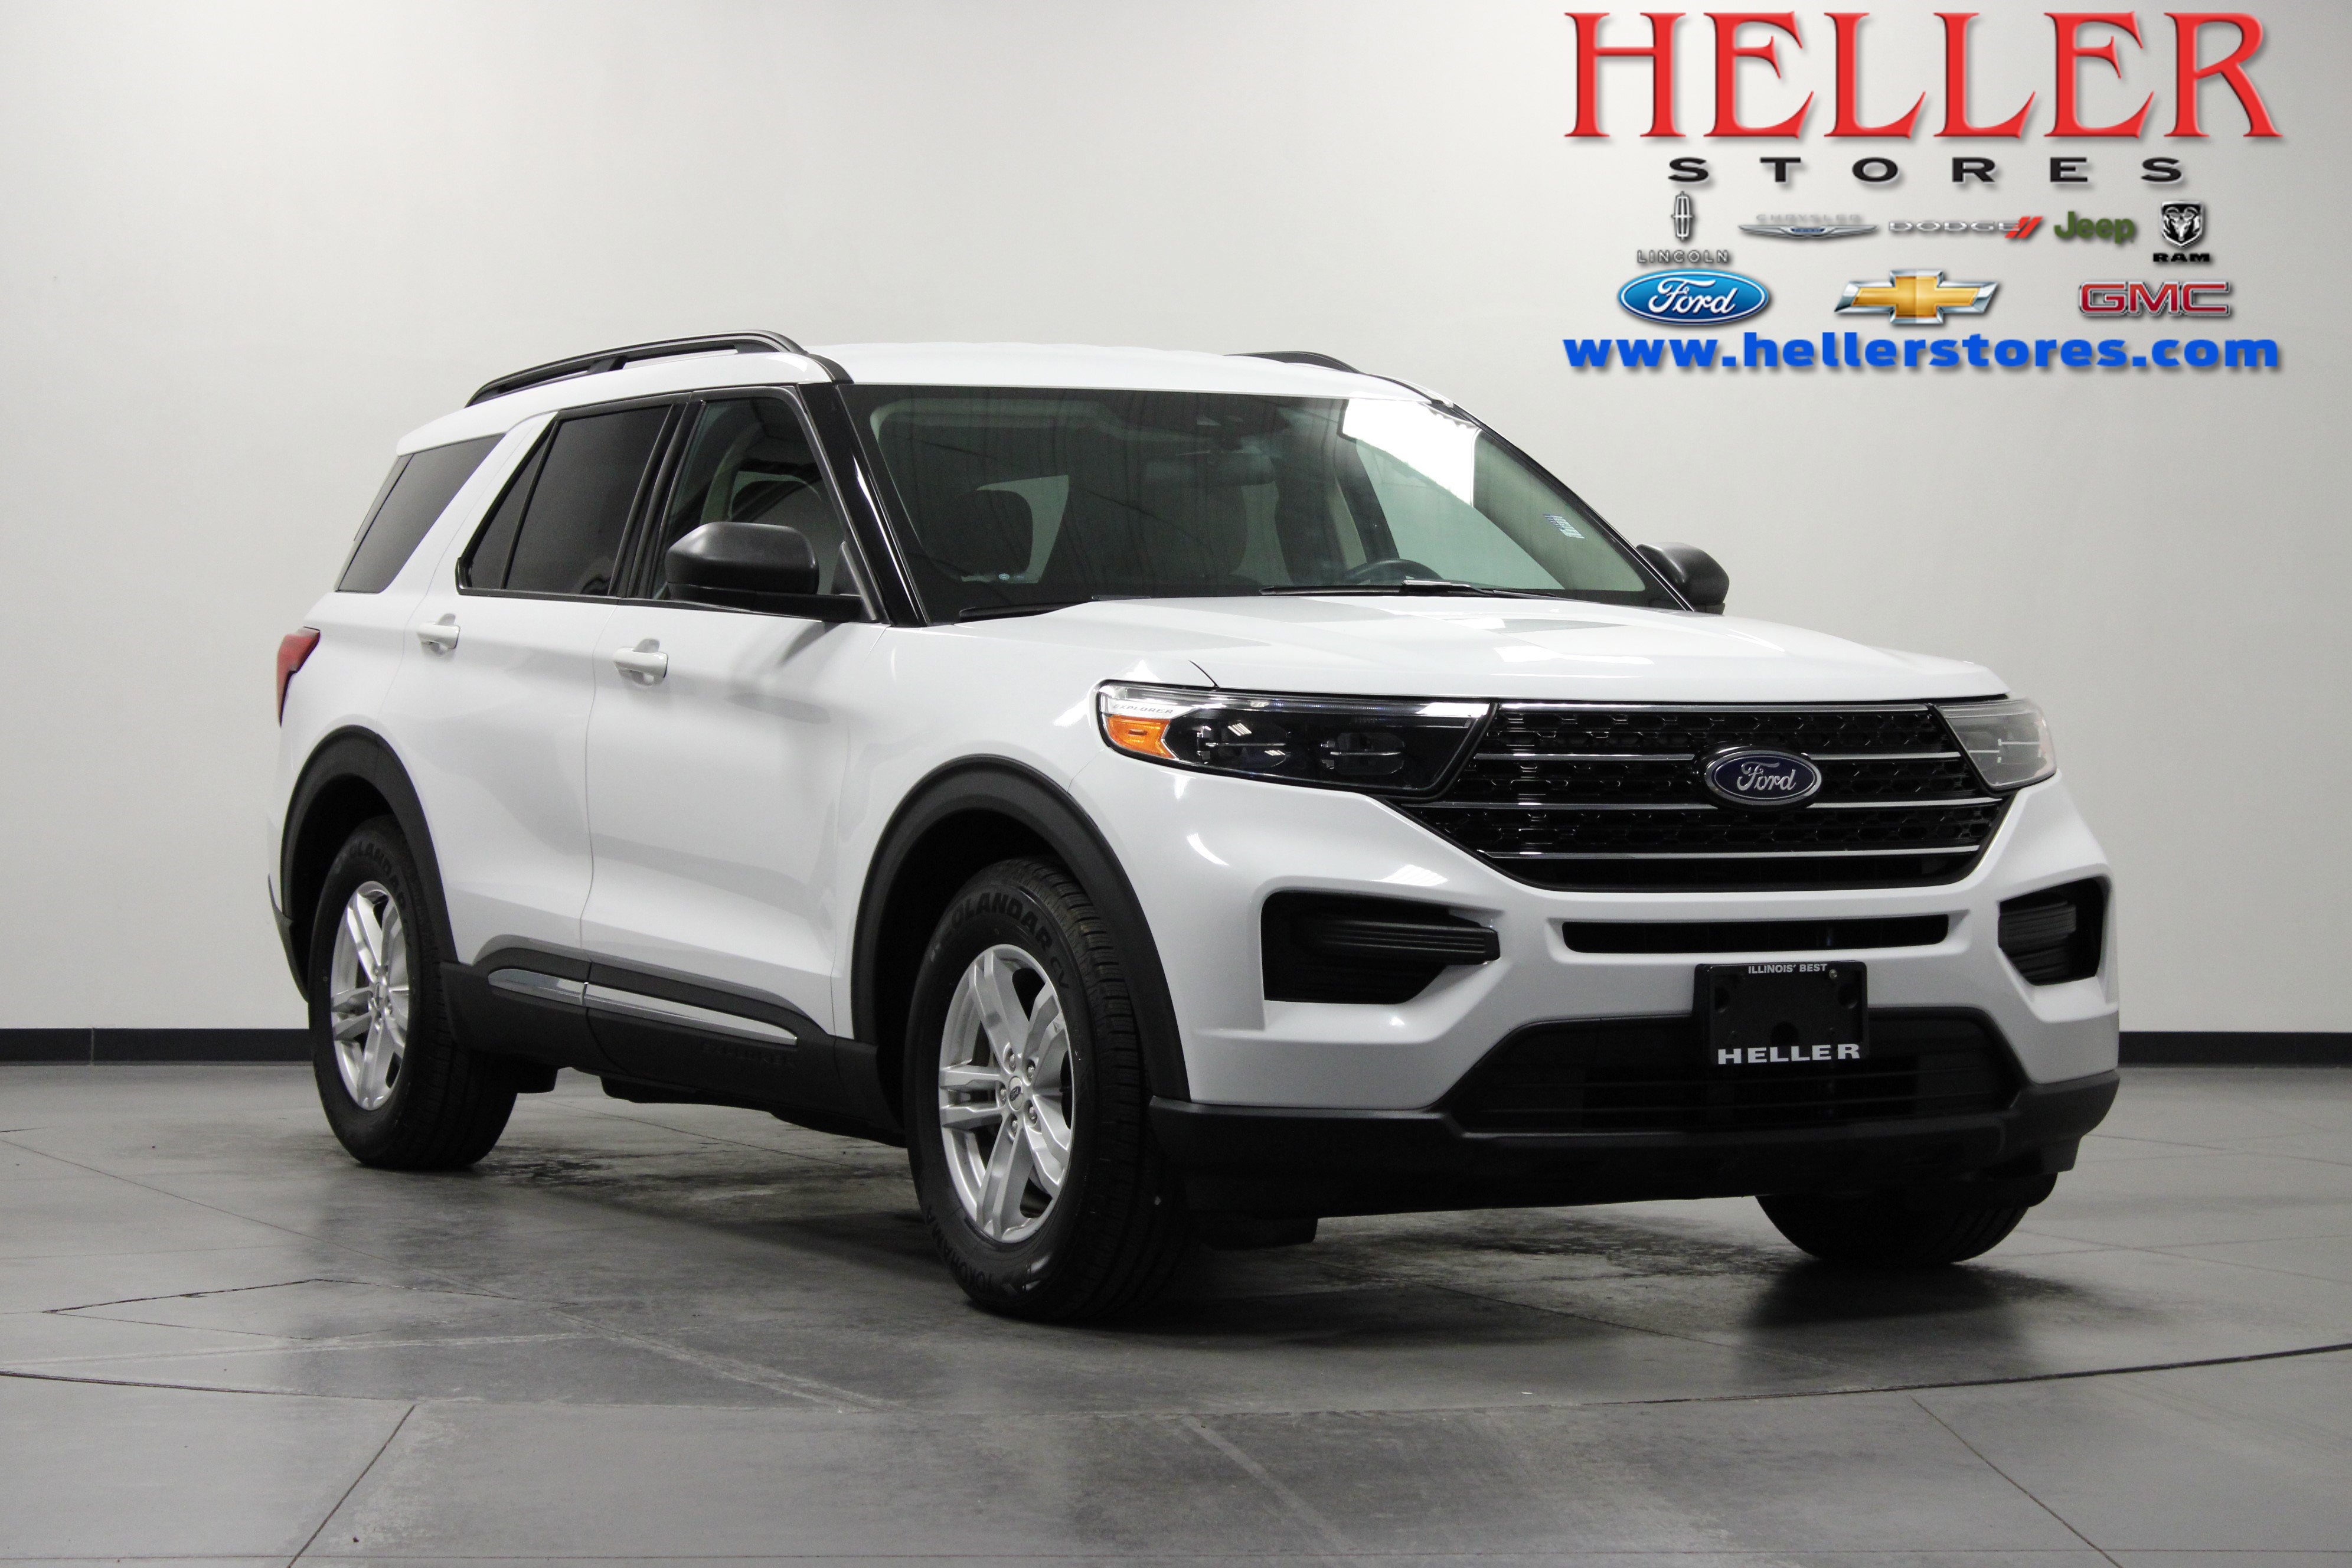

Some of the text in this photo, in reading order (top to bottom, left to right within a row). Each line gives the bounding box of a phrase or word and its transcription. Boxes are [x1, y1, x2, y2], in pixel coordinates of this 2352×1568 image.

[1113, 704, 1174, 714] EXPLORER
[1736, 761, 1796, 791] Ford
[1748, 963, 1827, 974] ILLINOIS' BEST
[1718, 1043, 1860, 1064] HELLER
